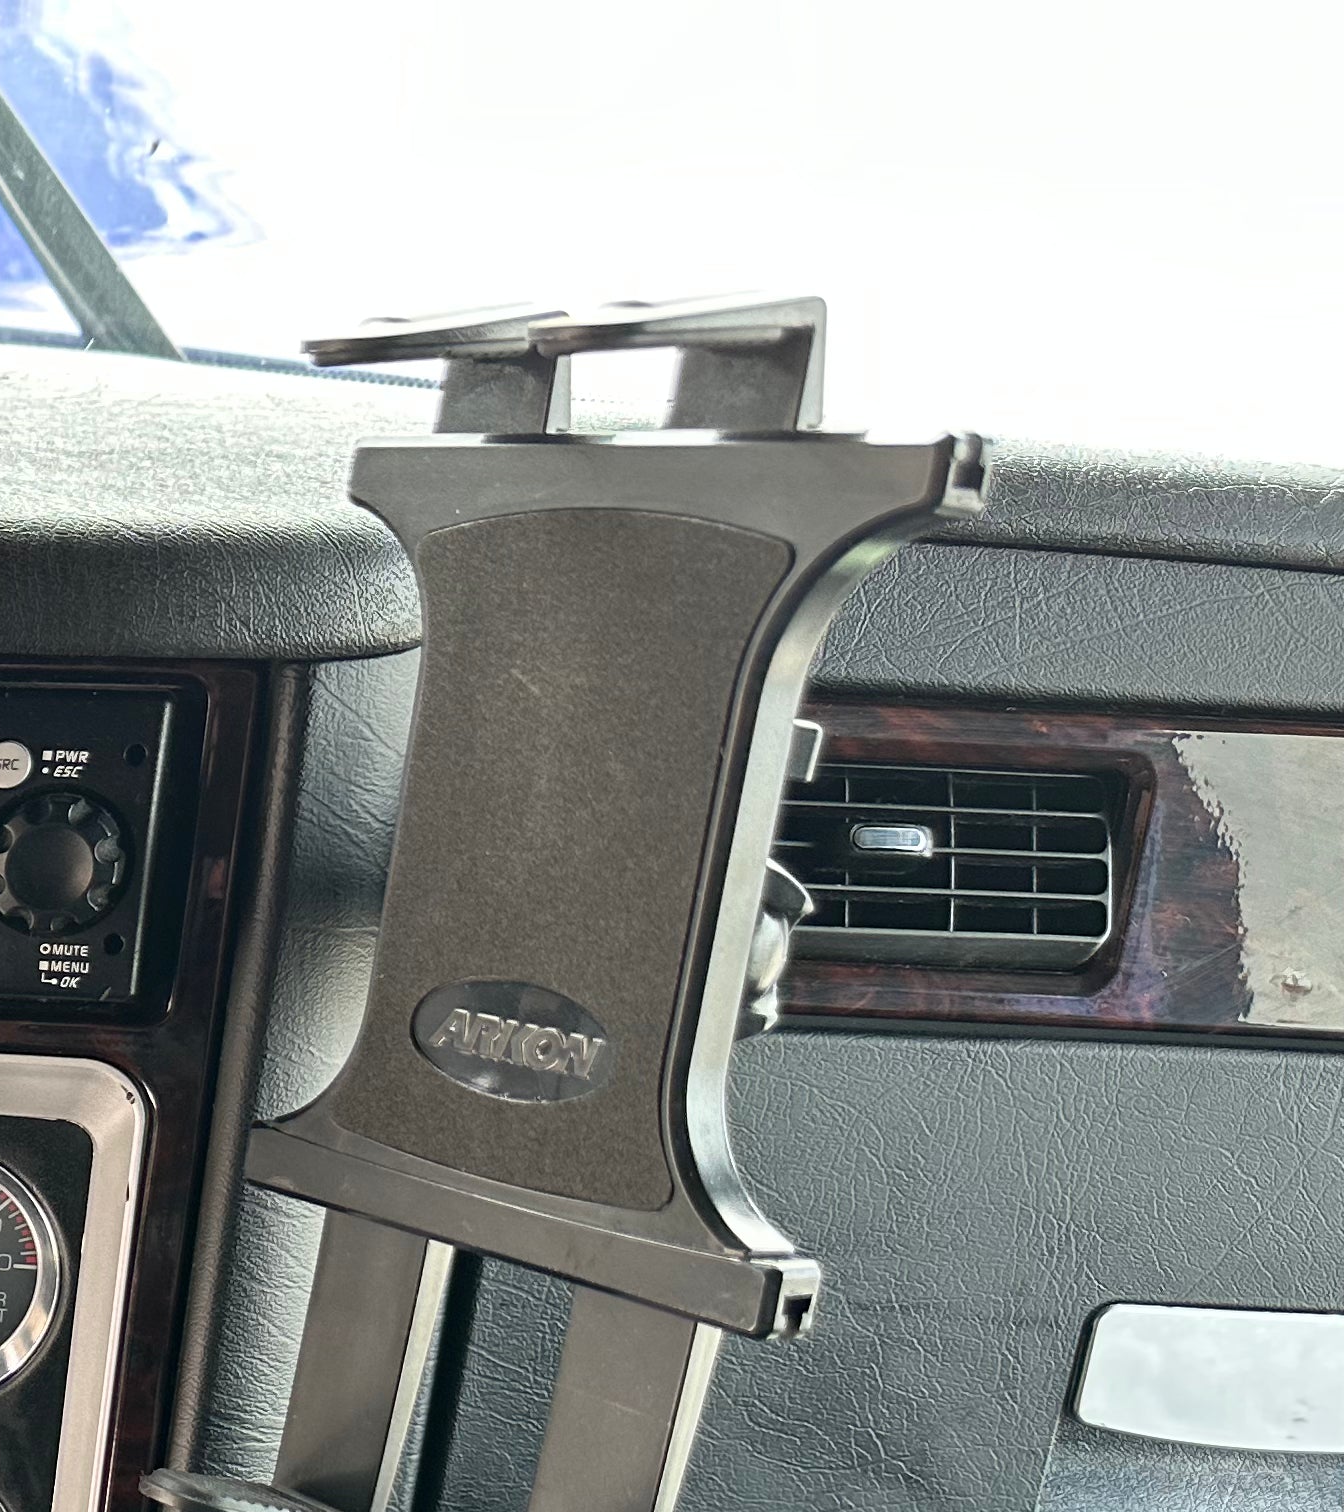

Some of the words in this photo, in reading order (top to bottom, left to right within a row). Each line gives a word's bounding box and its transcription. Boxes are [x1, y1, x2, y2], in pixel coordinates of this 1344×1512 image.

[55, 750, 89, 764] PWR
[53, 765, 83, 778] ESC
[52, 944, 89, 957] MUTE
[51, 960, 89, 974] MENU
[60, 976, 81, 988] OK
[428, 1007, 607, 1081] ARKON
